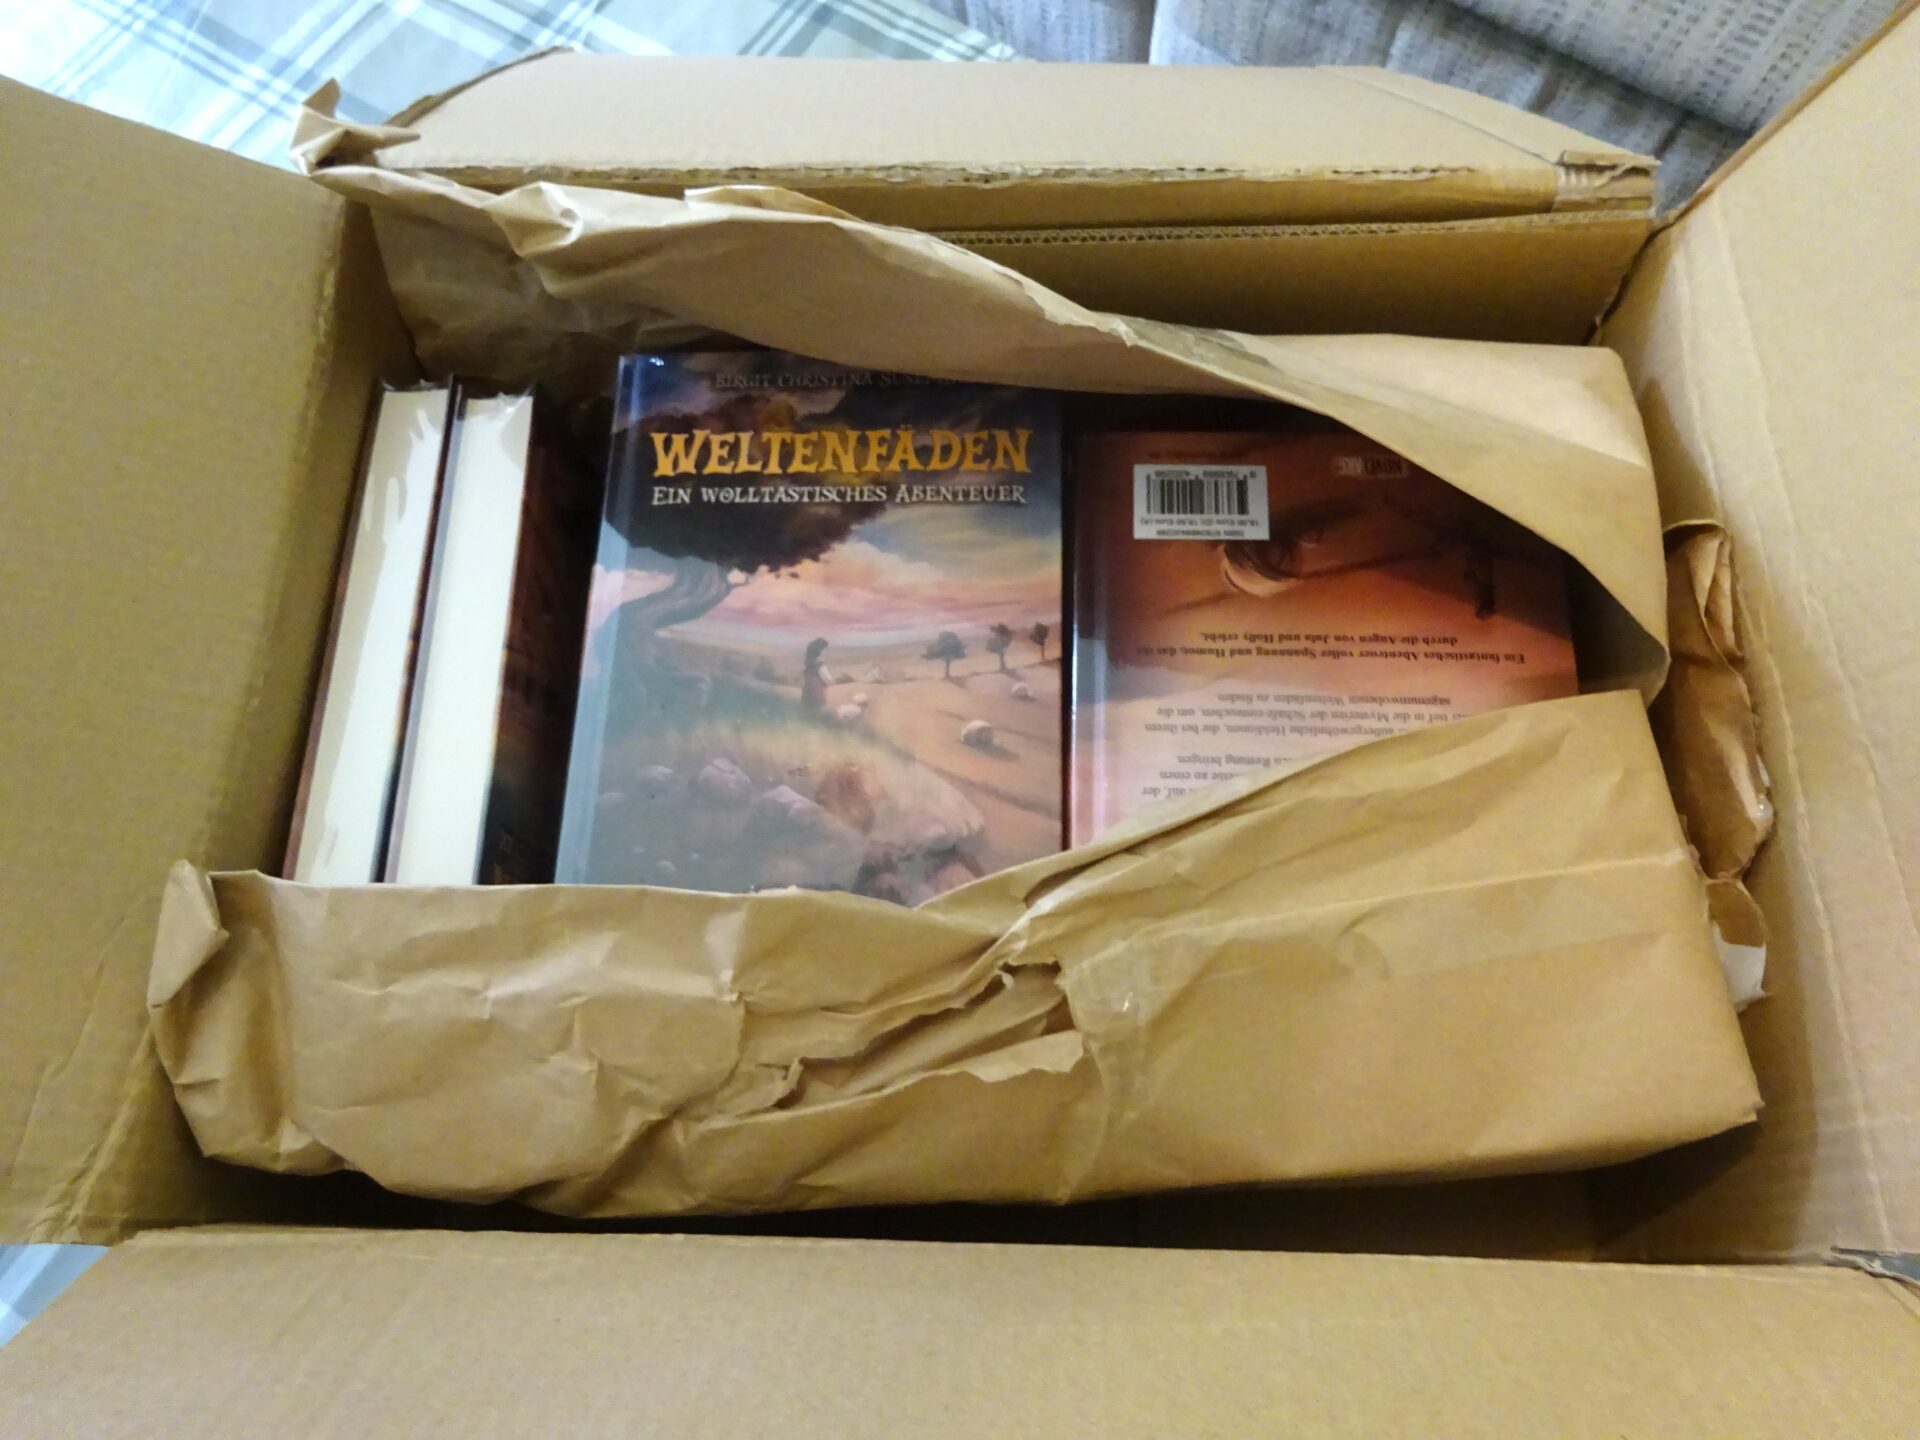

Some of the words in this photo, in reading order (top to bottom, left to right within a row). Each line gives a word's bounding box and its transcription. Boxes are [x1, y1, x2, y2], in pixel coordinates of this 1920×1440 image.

[715, 373, 772, 389] BIRGIT
[649, 424, 1032, 478] WELTENFÄDEN
[651, 485, 692, 506] EIN
[702, 485, 888, 504] WOLLTASTISCHES
[895, 483, 1027, 505] ABENTEUER
[1278, 634, 1301, 644] und
[1334, 634, 1355, 642] von
[1359, 633, 1397, 645] Augen
[1400, 636, 1420, 646] die
[1422, 636, 1458, 647] durch
[1229, 648, 1253, 659] und
[1256, 647, 1317, 660] Spannung
[1320, 650, 1354, 660] voller
[1359, 650, 1419, 662] Abenteuer
[1423, 652, 1500, 664] fantastisches
